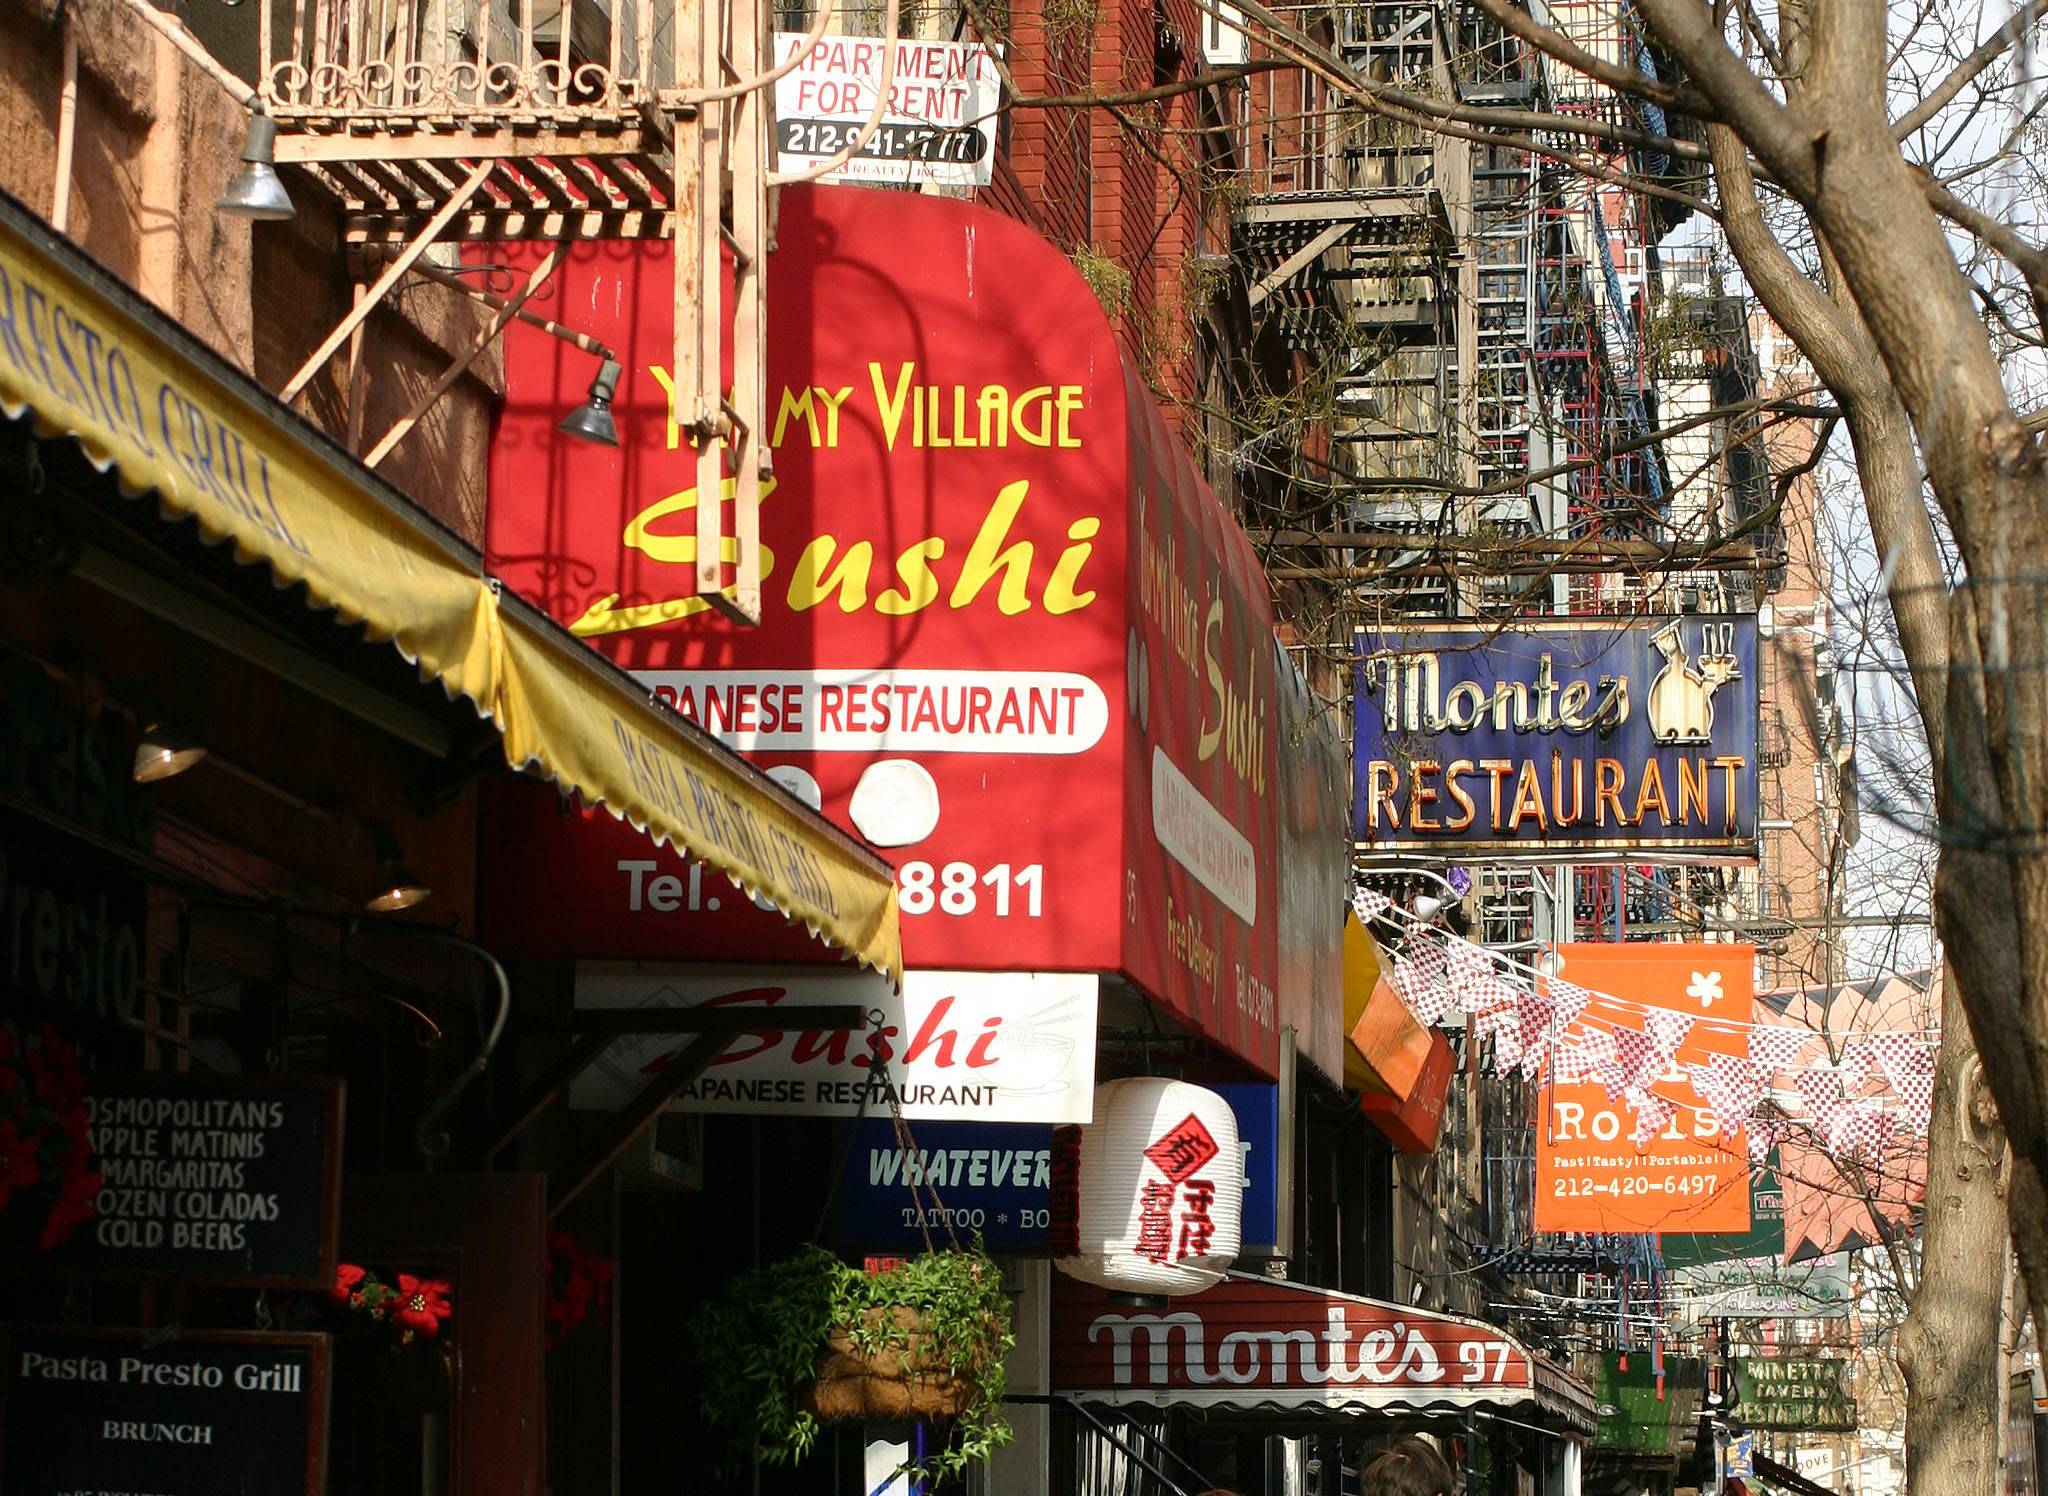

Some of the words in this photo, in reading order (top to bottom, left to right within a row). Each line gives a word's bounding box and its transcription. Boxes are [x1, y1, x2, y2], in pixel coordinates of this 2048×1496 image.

[798, 80, 860, 113] FOR
[886, 84, 968, 119] RENT
[868, 361, 1085, 452] VILLAGE
[568, 474, 1102, 637] Sushi
[820, 684, 1084, 736] RESTAURANT
[1198, 597, 1266, 798] Sushi
[1368, 750, 1746, 836] RESTAURANT
[617, 860, 721, 912] Tel.
[640, 987, 1003, 1073] Sushi
[816, 1080, 998, 1106] RESTAURANT
[171, 1130, 266, 1159] MATINIS
[101, 1160, 245, 1189] MARGARITAS
[868, 1148, 1051, 1190] WHATEVER
[1554, 1175, 1718, 1198] 212-420-6497
[173, 1192, 280, 1222] COLADAS
[901, 1208, 986, 1229] TATTOO
[97, 1220, 164, 1249] COLD
[172, 1222, 248, 1250] BEERS
[1088, 1307, 1446, 1384] Monte's
[1459, 1341, 1511, 1384] 97
[20, 1351, 109, 1383] Pasta
[119, 1356, 224, 1389] Presto
[234, 1363, 302, 1393] Grill
[1747, 1362, 1835, 1380] MINETTA
[1757, 1383, 1829, 1399] TAVERN
[103, 1420, 213, 1446] BRUNCH
